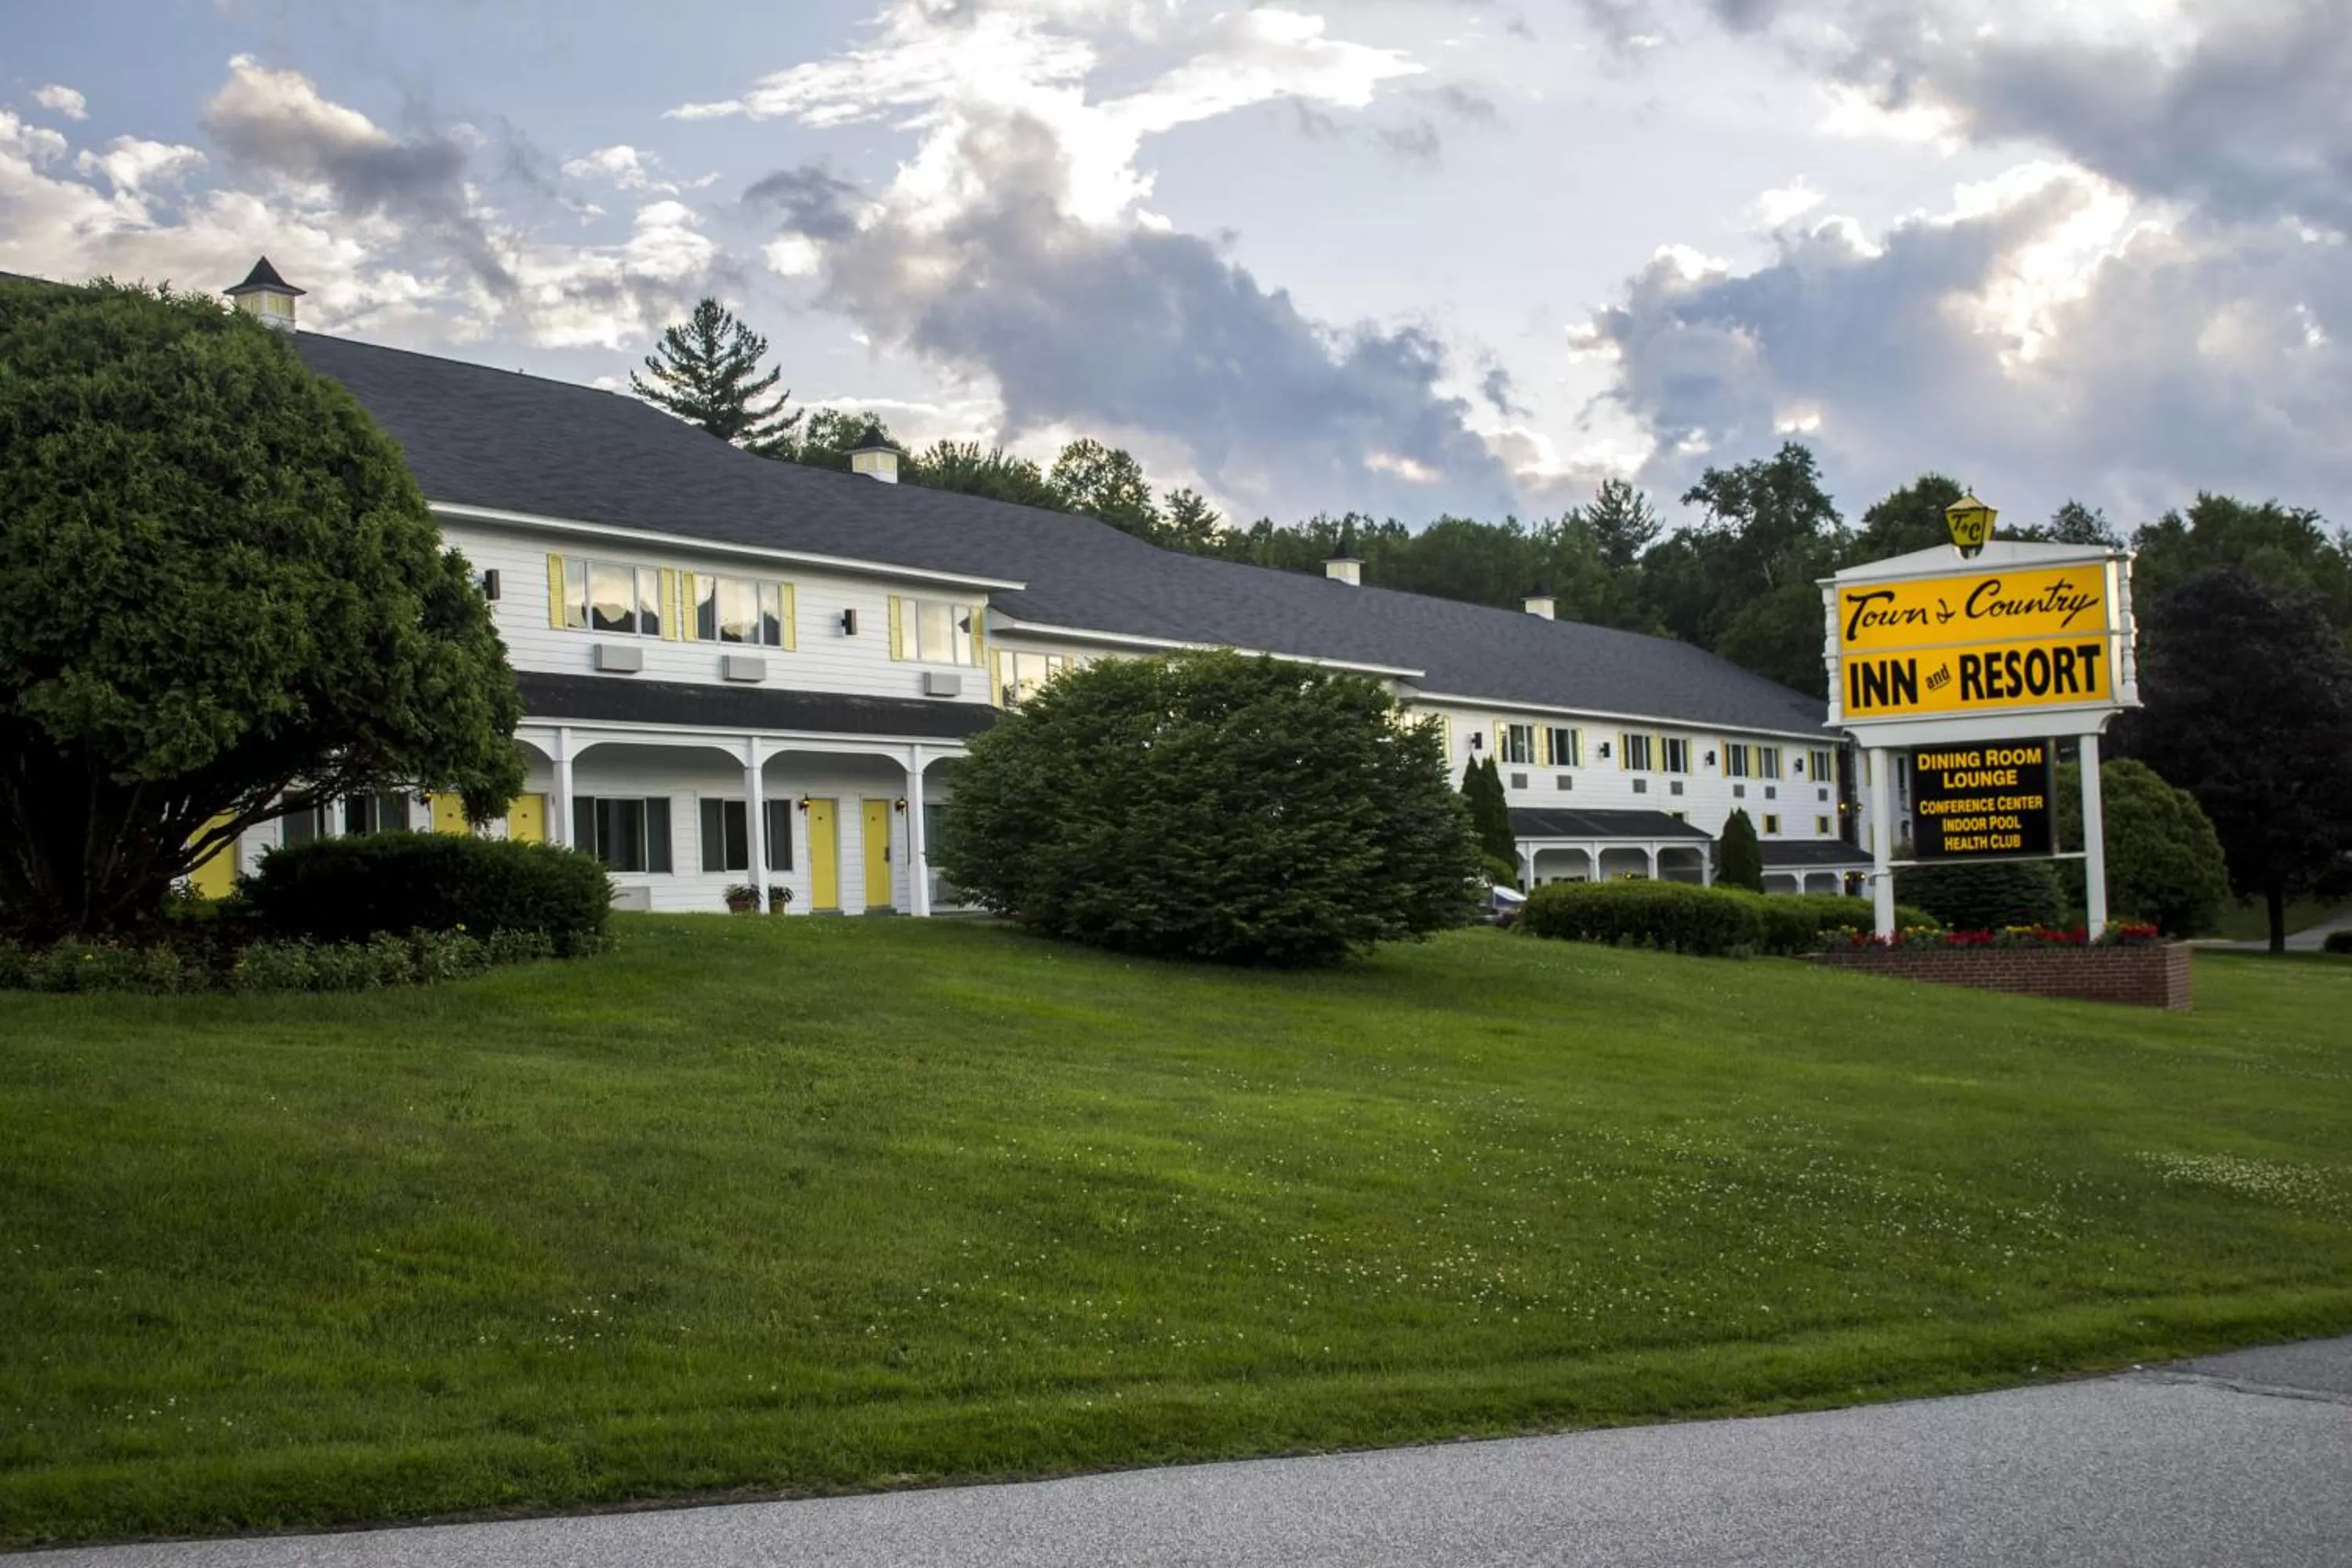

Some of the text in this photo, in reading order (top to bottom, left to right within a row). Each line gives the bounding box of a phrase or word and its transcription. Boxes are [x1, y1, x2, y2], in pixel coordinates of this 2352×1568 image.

[1846, 590, 1928, 641] Town
[1965, 579, 2099, 628] Country
[1849, 644, 2101, 709] INN and RESORT
[1918, 748, 2042, 771] DINING ROOM
[1943, 769, 2018, 789] LOUNGE
[1919, 795, 2043, 815] CONFERENCE CENTER
[1943, 815, 2022, 833] INDOOR POOL
[1944, 833, 2021, 851] HEALTH CLUB
